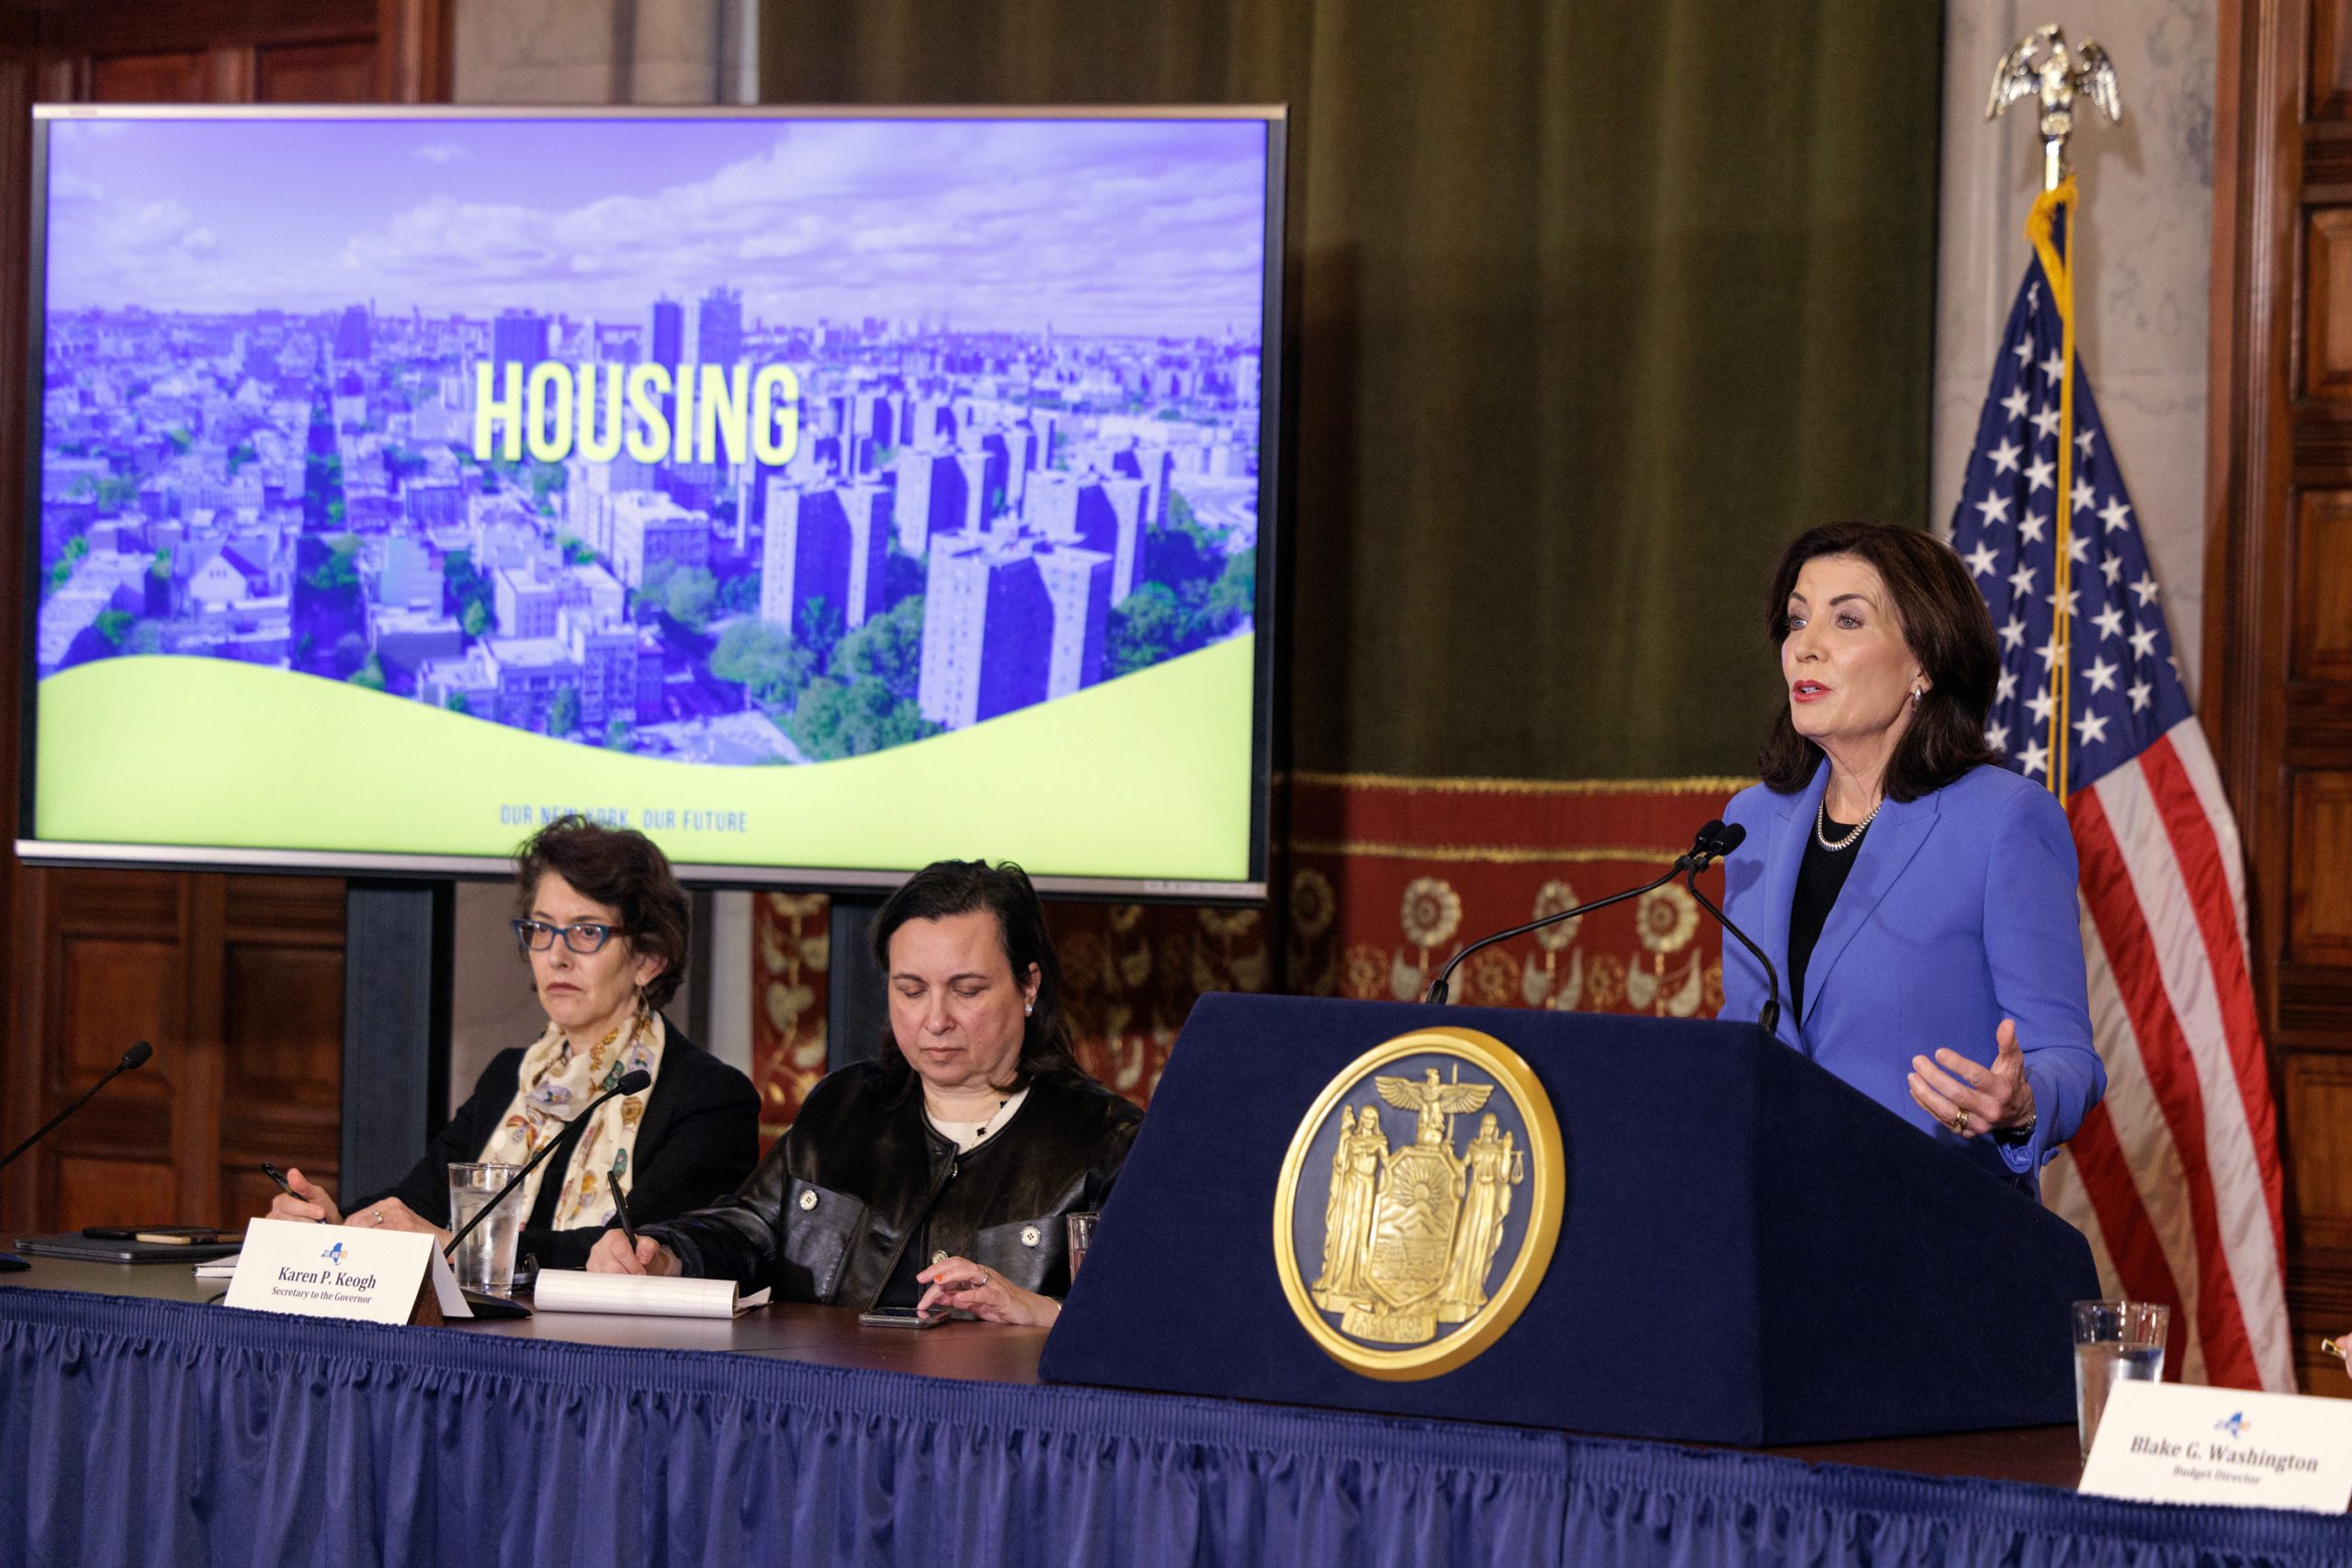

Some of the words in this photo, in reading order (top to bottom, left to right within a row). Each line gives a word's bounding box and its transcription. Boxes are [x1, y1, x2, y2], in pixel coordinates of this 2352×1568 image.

[474, 361, 800, 467] HOUSING
[501, 804, 533, 825] OUR
[643, 809, 676, 830] OUR
[683, 811, 748, 833] FUTURE
[278, 1267, 318, 1283] Karen
[321, 1271, 332, 1284] P.
[334, 1272, 376, 1292] Keogh
[272, 1286, 310, 1300] Secretary
[311, 1290, 319, 1299] to
[320, 1292, 334, 1300] the
[334, 1292, 371, 1303] Governor
[2130, 1435, 2182, 1459] Blake
[2186, 1442, 2202, 1460] G.
[2210, 1443, 2318, 1473] Washington
